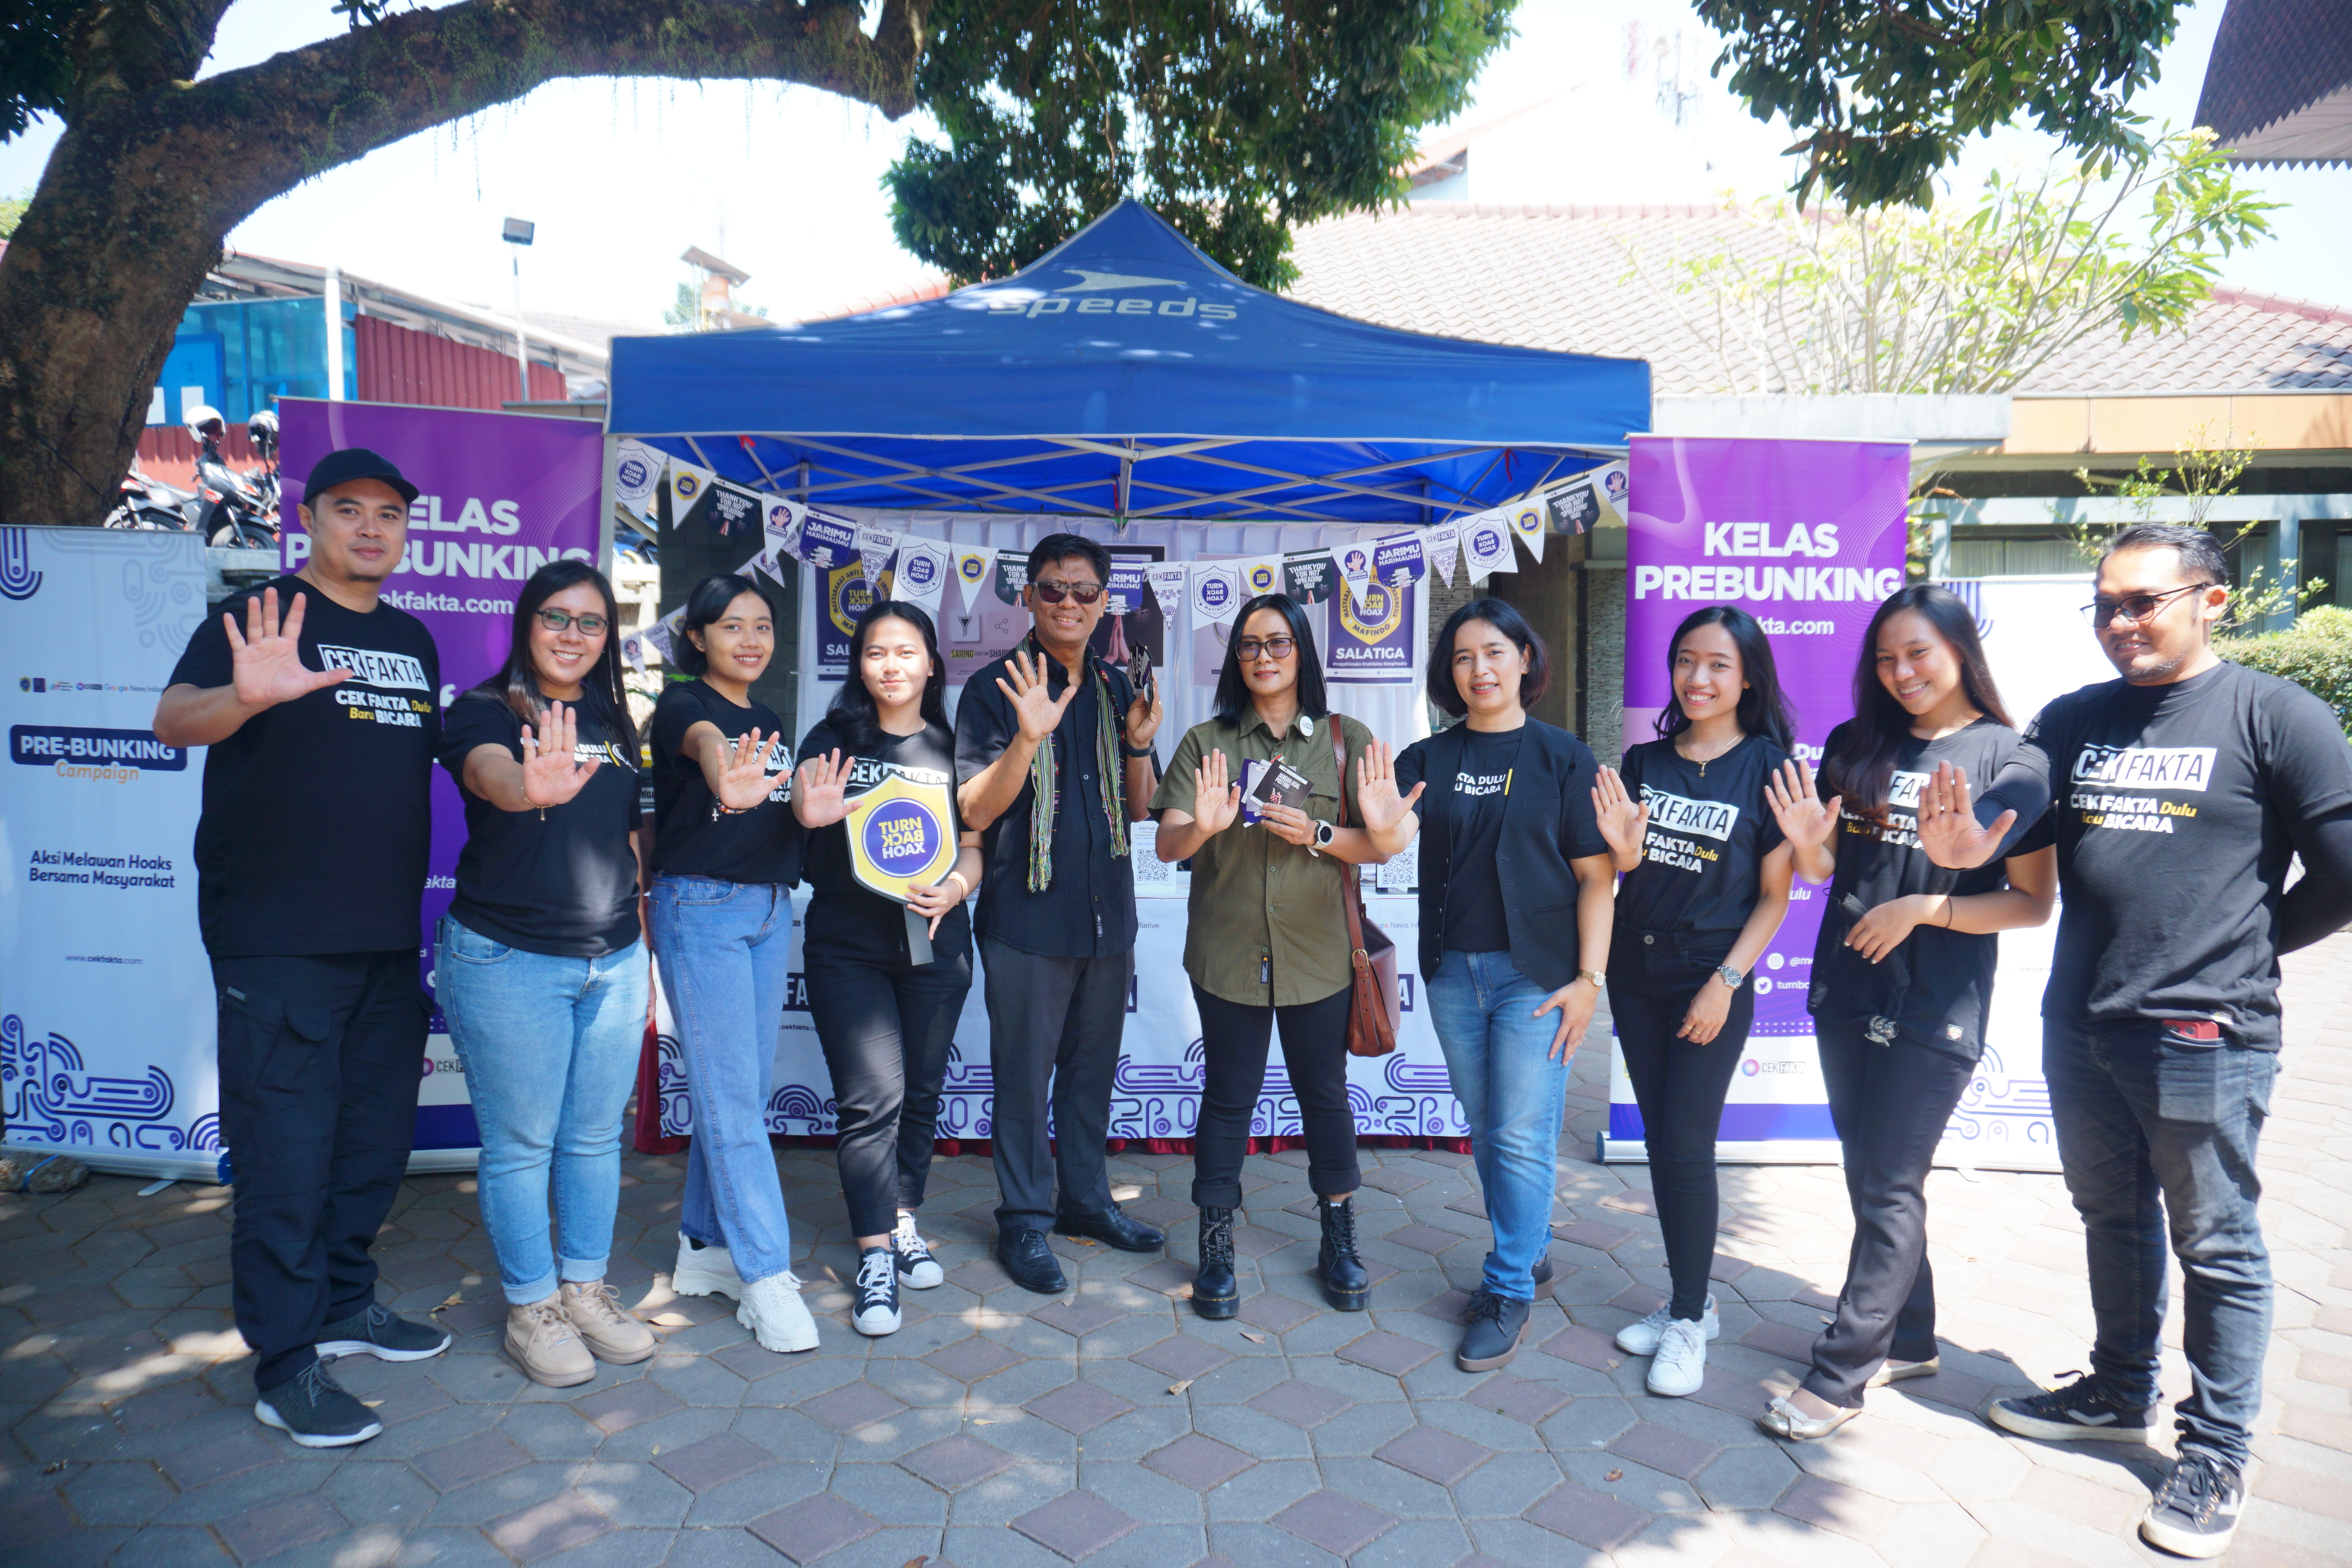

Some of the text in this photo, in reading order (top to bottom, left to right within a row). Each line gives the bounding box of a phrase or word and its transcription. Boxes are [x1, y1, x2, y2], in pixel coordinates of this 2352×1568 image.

[987, 298, 1237, 319] speeds
[627, 462, 643, 474] TURN
[621, 474, 639, 486] HOAX
[1609, 479, 1624, 490] STOP
[616, 481, 639, 494] MAFINDO
[717, 503, 745, 519] SPREADING
[720, 497, 745, 511] FOR NOT
[1560, 497, 1585, 511] FOR NOT
[1560, 503, 1588, 518] SPREADING
[408, 495, 520, 536] ELAS
[723, 512, 735, 521] HOAX
[1570, 511, 1581, 521] HOAX
[806, 530, 849, 547] HARIMAUMU
[808, 522, 851, 541] JARIMU
[1427, 535, 1437, 543] CEK
[1437, 530, 1455, 541] FAKTA
[1477, 532, 1494, 542] TURN
[1496, 527, 1506, 549] INDONESIA
[862, 533, 892, 546] CEK FAKTA
[1704, 522, 1839, 558] KELAS
[1378, 544, 1420, 560] JARIMU
[1479, 544, 1497, 554] HOAX
[901, 552, 913, 575] MASYARAKAT
[924, 550, 936, 561] FITNAH
[913, 559, 930, 568] TURN
[1348, 559, 1364, 568] STOP
[1379, 552, 1421, 566] HARIMAUMU
[1479, 552, 1501, 562] MAFINDO
[911, 572, 928, 580] HOAX
[1109, 573, 1140, 583] RIMU
[1295, 575, 1323, 585] SPREADING
[1296, 570, 1308, 579] FOR
[906, 581, 929, 590] MAFINDO
[1196, 577, 1205, 602] MASYARAKAT
[1215, 572, 1228, 580] FITNAH
[1635, 565, 1901, 601] PREBUNKING
[831, 570, 859, 613] MASYARAKAT ANTI
[379, 590, 514, 615] ekfakta.com
[1390, 588, 1399, 617] NDONESIA
[1352, 624, 1390, 636] MAFINDO
[1758, 616, 1834, 635] kta.com
[951, 650, 974, 658] SARING
[1336, 647, 1405, 659] SALATIGA
[365, 655, 425, 684] FAKTA
[104, 683, 129, 693] Google
[335, 690, 432, 713] CEK FAKTA Dulu
[350, 707, 375, 720] Baru
[20, 735, 176, 760] PRE-BUNKING
[56, 762, 139, 784] Campaign
[2125, 754, 2203, 782] FAKTA
[1275, 777, 1290, 789] POSTING
[1278, 773, 1292, 784] JANGAN
[1291, 779, 1301, 790] ASAL
[1456, 772, 1506, 785] KTA DULU
[769, 790, 791, 802] BICA
[1465, 784, 1501, 796] BICARA
[2071, 794, 2197, 817] CEK FAKTA Dulu
[1666, 799, 1730, 834] FAKTA
[1887, 813, 1917, 831] KTA
[2102, 813, 2174, 833] BICARA
[878, 817, 923, 835] TURN
[882, 842, 926, 859] HOAX
[1645, 832, 1719, 861] FAKTA Dulu
[31, 850, 172, 870] Aksi Melawan Hoaks
[1649, 848, 1702, 873] BICARA
[29, 867, 175, 889] Bersama Masyarakat
[424, 875, 456, 889] akta
[1789, 887, 1811, 900] ulu
[65, 955, 143, 965] www.cekfakta.com
[437, 1061, 455, 1071] CEK
[1762, 1062, 1778, 1073] CEK
